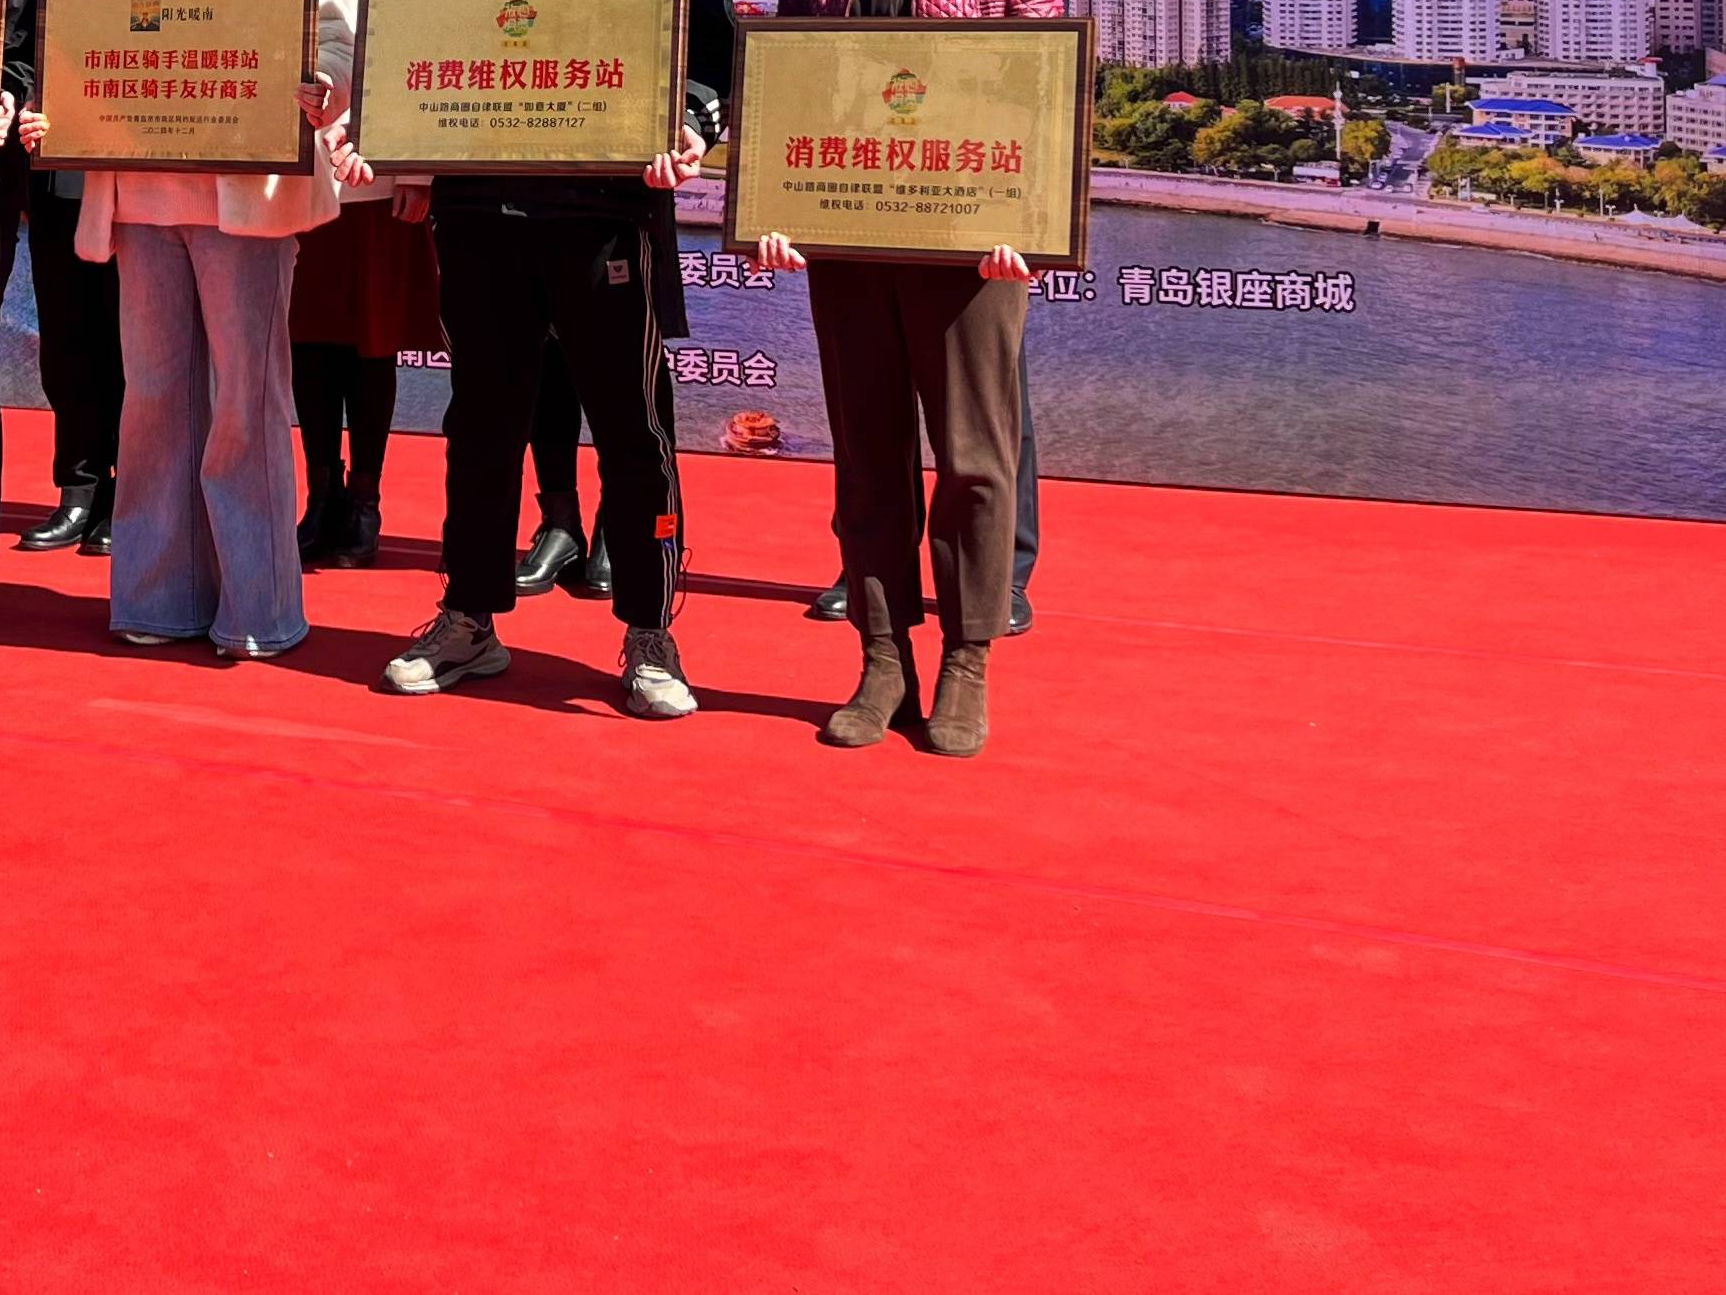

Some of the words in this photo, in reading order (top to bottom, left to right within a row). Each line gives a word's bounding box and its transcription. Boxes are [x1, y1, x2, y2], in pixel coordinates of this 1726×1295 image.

[84, 49, 260, 71] 市南区骑手温暖驿站
[405, 57, 625, 92] 消费维权服务站
[83, 78, 259, 100] 市南区骑手友好商家
[784, 134, 1024, 175] 消费维权服务站
[665, 347, 776, 388] 委员会
